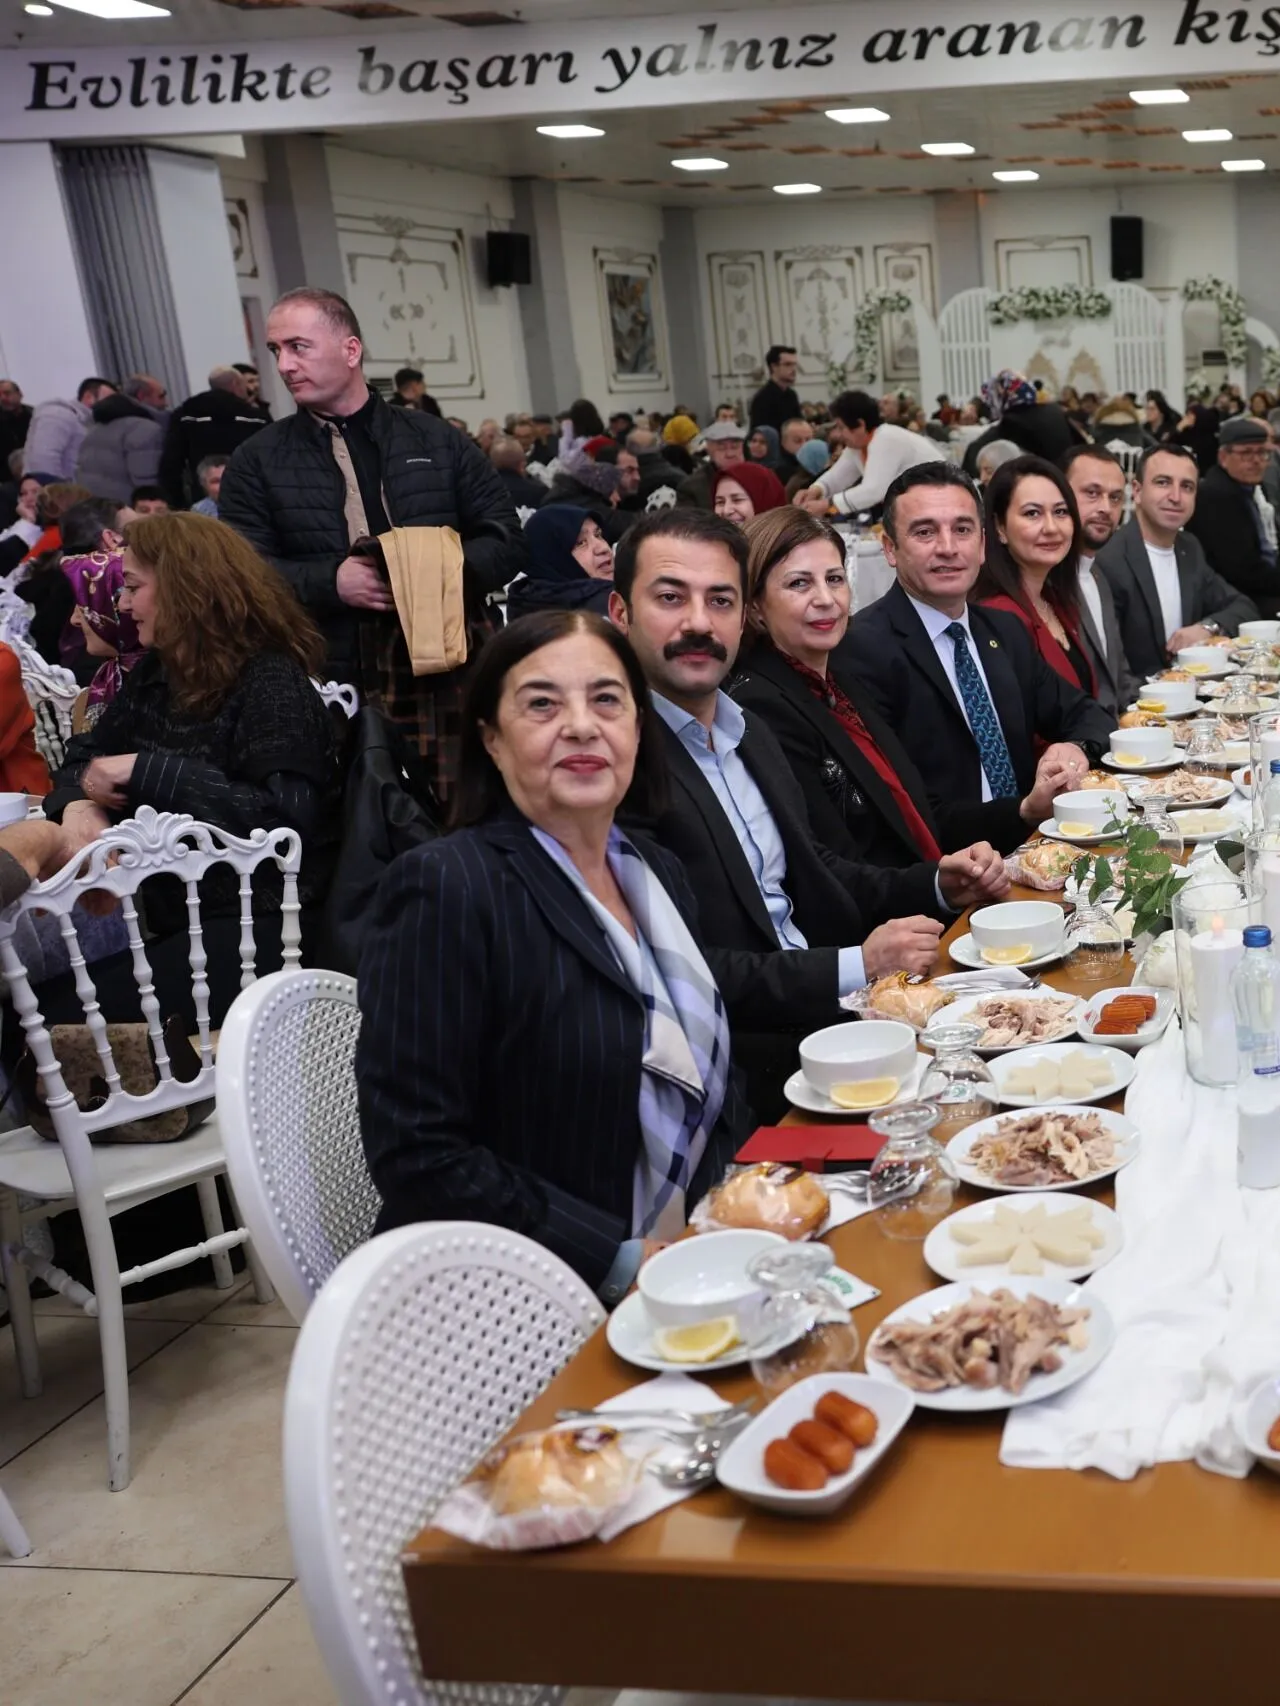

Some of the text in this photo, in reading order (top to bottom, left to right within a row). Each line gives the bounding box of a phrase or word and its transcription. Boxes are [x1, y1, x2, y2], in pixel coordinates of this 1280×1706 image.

[24, 52, 332, 111] Evlilikte
[356, 45, 578, 105] başarı
[594, 23, 837, 93] yalnız
[862, 14, 1147, 63] aranan
